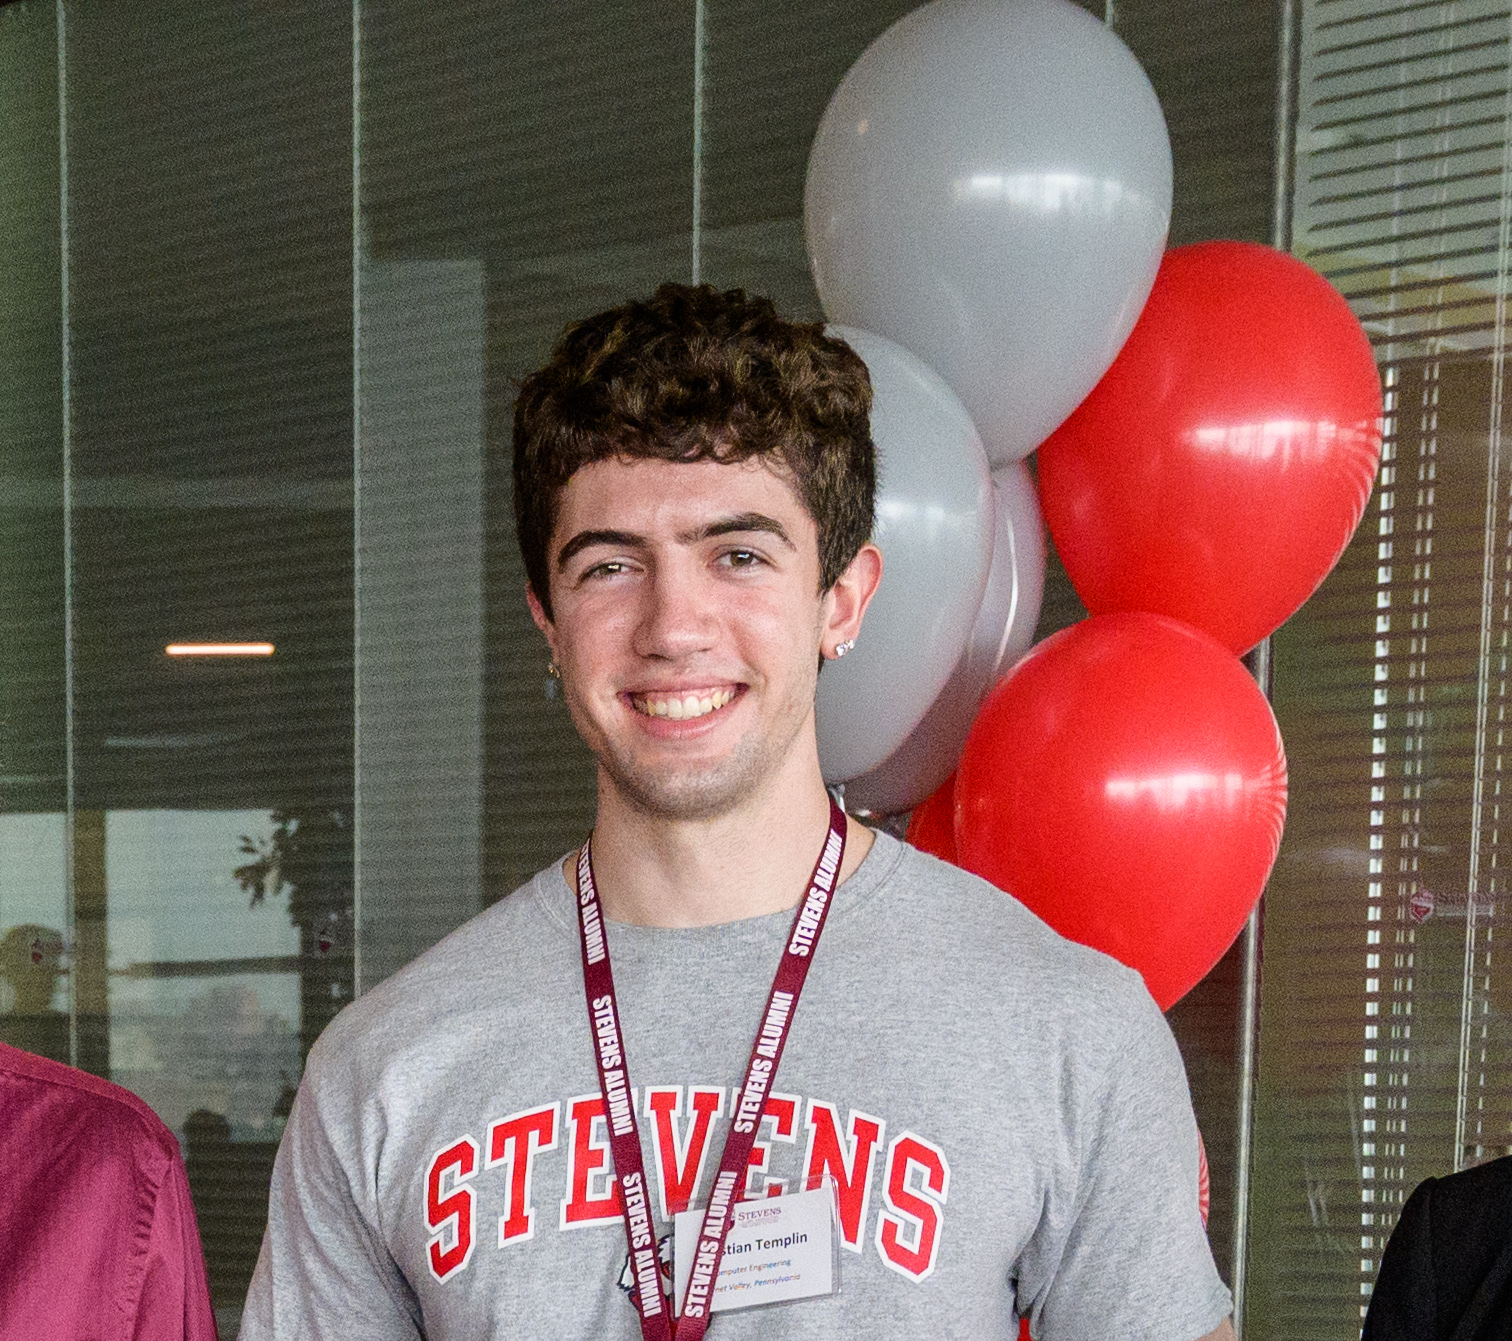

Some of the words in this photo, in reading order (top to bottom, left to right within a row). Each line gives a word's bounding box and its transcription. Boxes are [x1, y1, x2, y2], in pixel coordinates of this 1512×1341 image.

[789, 887, 827, 957] STEVENS
[814, 828, 843, 892] ALUMNI
[582, 902, 606, 965] ALUMNI
[593, 995, 622, 1070] STEVENS
[734, 1058, 773, 1134] STEVENS
[756, 990, 794, 1059] ALUMNI
[604, 1069, 634, 1136] ALUMNI
[424, 1084, 952, 1285] STEVENS
[623, 1172, 651, 1249] STEVENS
[738, 1207, 782, 1221] STEVENS
[684, 1240, 720, 1318] STEVENS
[703, 1171, 738, 1239] ALUMNI
[749, 1259, 792, 1273] Engineering
[755, 1232, 808, 1251] Templin
[634, 1249, 663, 1318] ALUMNI
[754, 1274, 801, 1287] Pennsylvania
